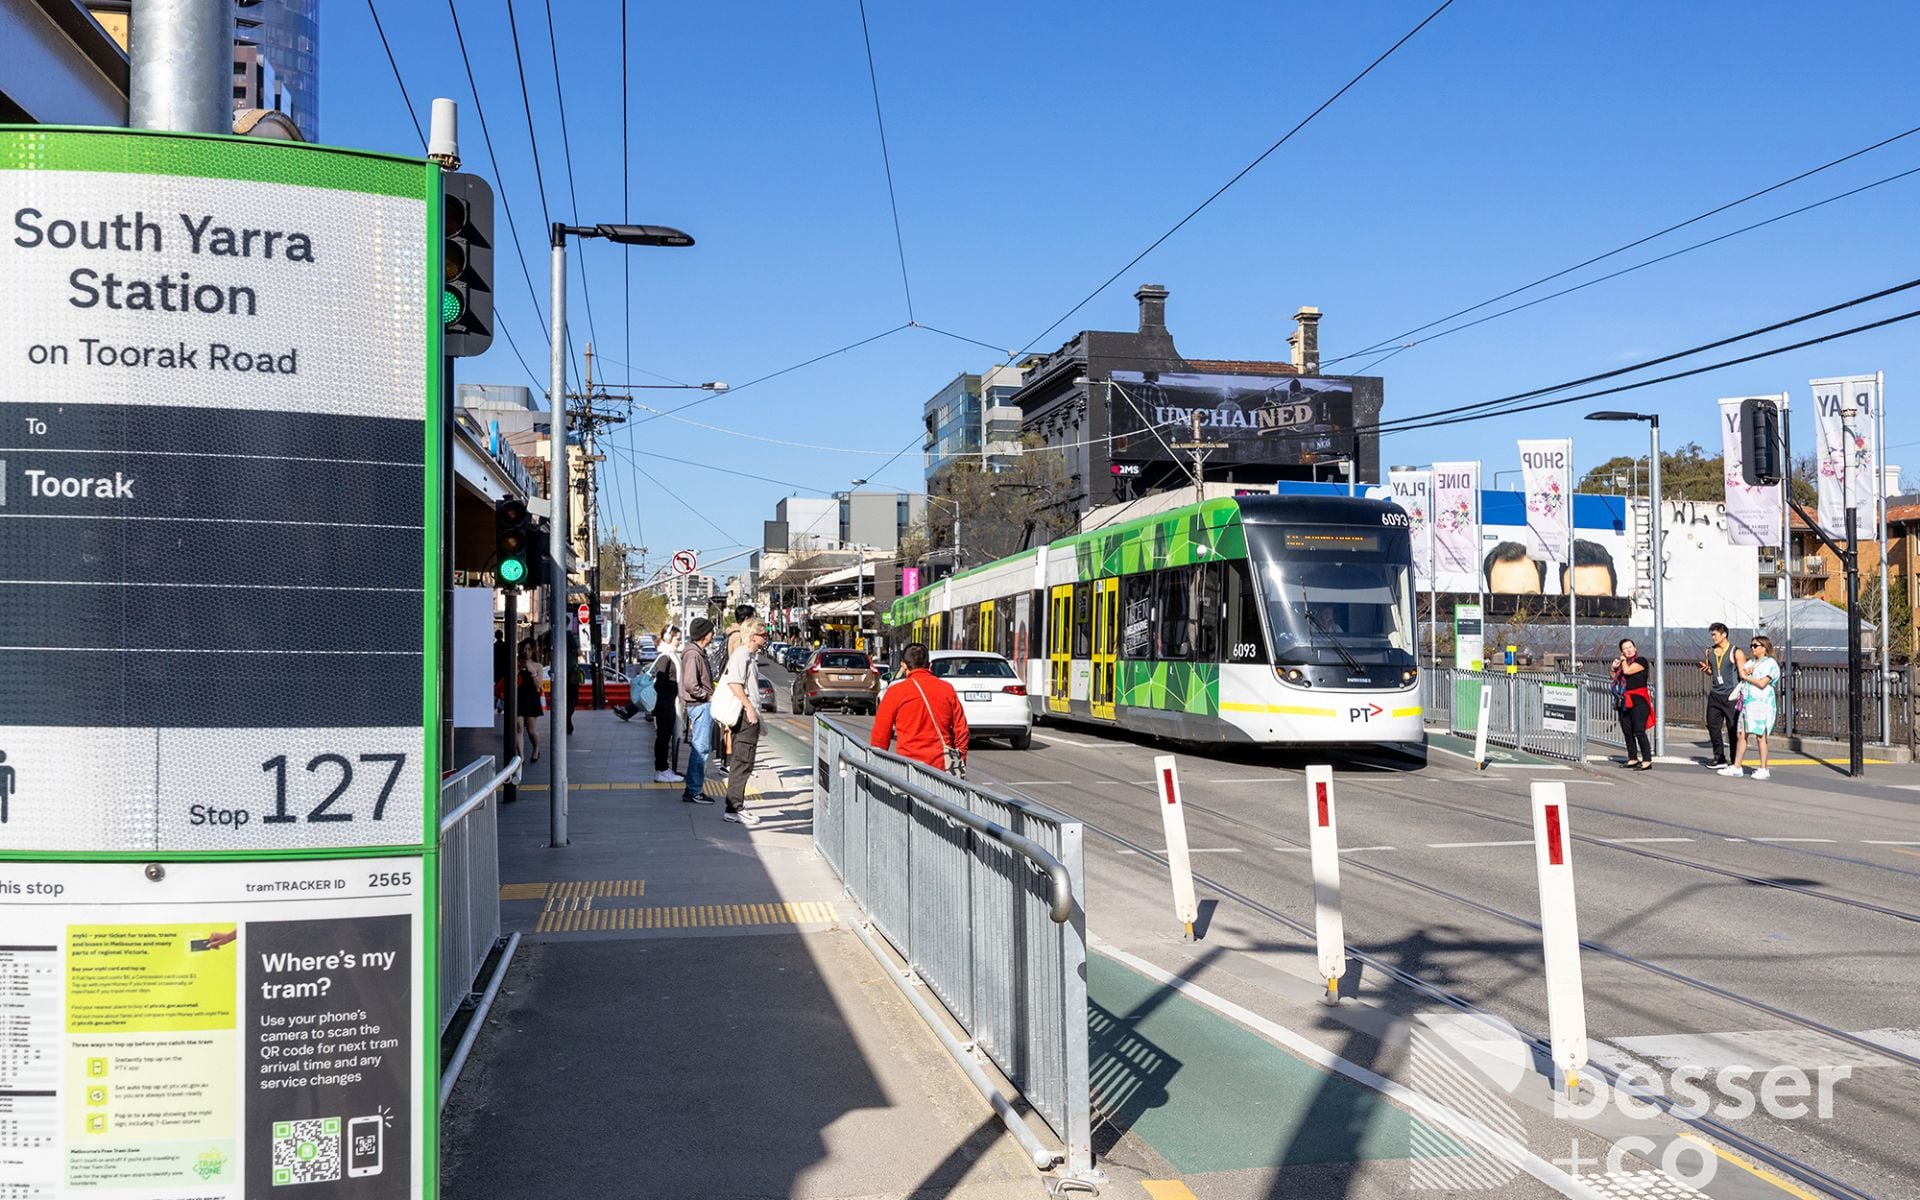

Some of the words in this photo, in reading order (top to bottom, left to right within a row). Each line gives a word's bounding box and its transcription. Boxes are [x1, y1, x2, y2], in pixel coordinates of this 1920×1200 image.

[14, 207, 162, 253] South
[179, 213, 315, 264] Yarra
[69, 268, 257, 316] Station
[27, 344, 68, 365] on
[79, 338, 198, 370] Toorak
[210, 343, 298, 375] Road
[25, 417, 48, 435] To
[1155, 404, 1313, 431] UNCHAINED
[24, 469, 134, 500] Toorak
[1381, 512, 1410, 528] 6093
[1232, 642, 1257, 659] 6093
[189, 804, 249, 831] Stop
[261, 752, 406, 825] 127
[26, 881, 65, 898] stop
[245, 880, 331, 893] tramTRACKER
[333, 879, 347, 890] ID
[368, 872, 412, 888] 2565
[361, 949, 396, 971] my
[261, 976, 332, 1001] tram?
[260, 1015, 285, 1028] Use
[288, 1013, 317, 1030] your
[260, 1030, 309, 1044] camera
[310, 1029, 325, 1042] to
[327, 1027, 359, 1040] scan
[359, 1024, 381, 1038] the
[260, 1045, 281, 1060] QR
[282, 1043, 315, 1057] code
[317, 1041, 336, 1055] for
[338, 1040, 367, 1054] next
[370, 1038, 399, 1051] tram
[260, 1059, 301, 1075] arrival
[302, 1058, 332, 1072] time
[333, 1055, 361, 1071] and
[360, 1055, 382, 1072] any
[260, 1075, 308, 1091] service
[309, 1071, 363, 1090] changes
[198, 1167, 222, 1175] ZONE
